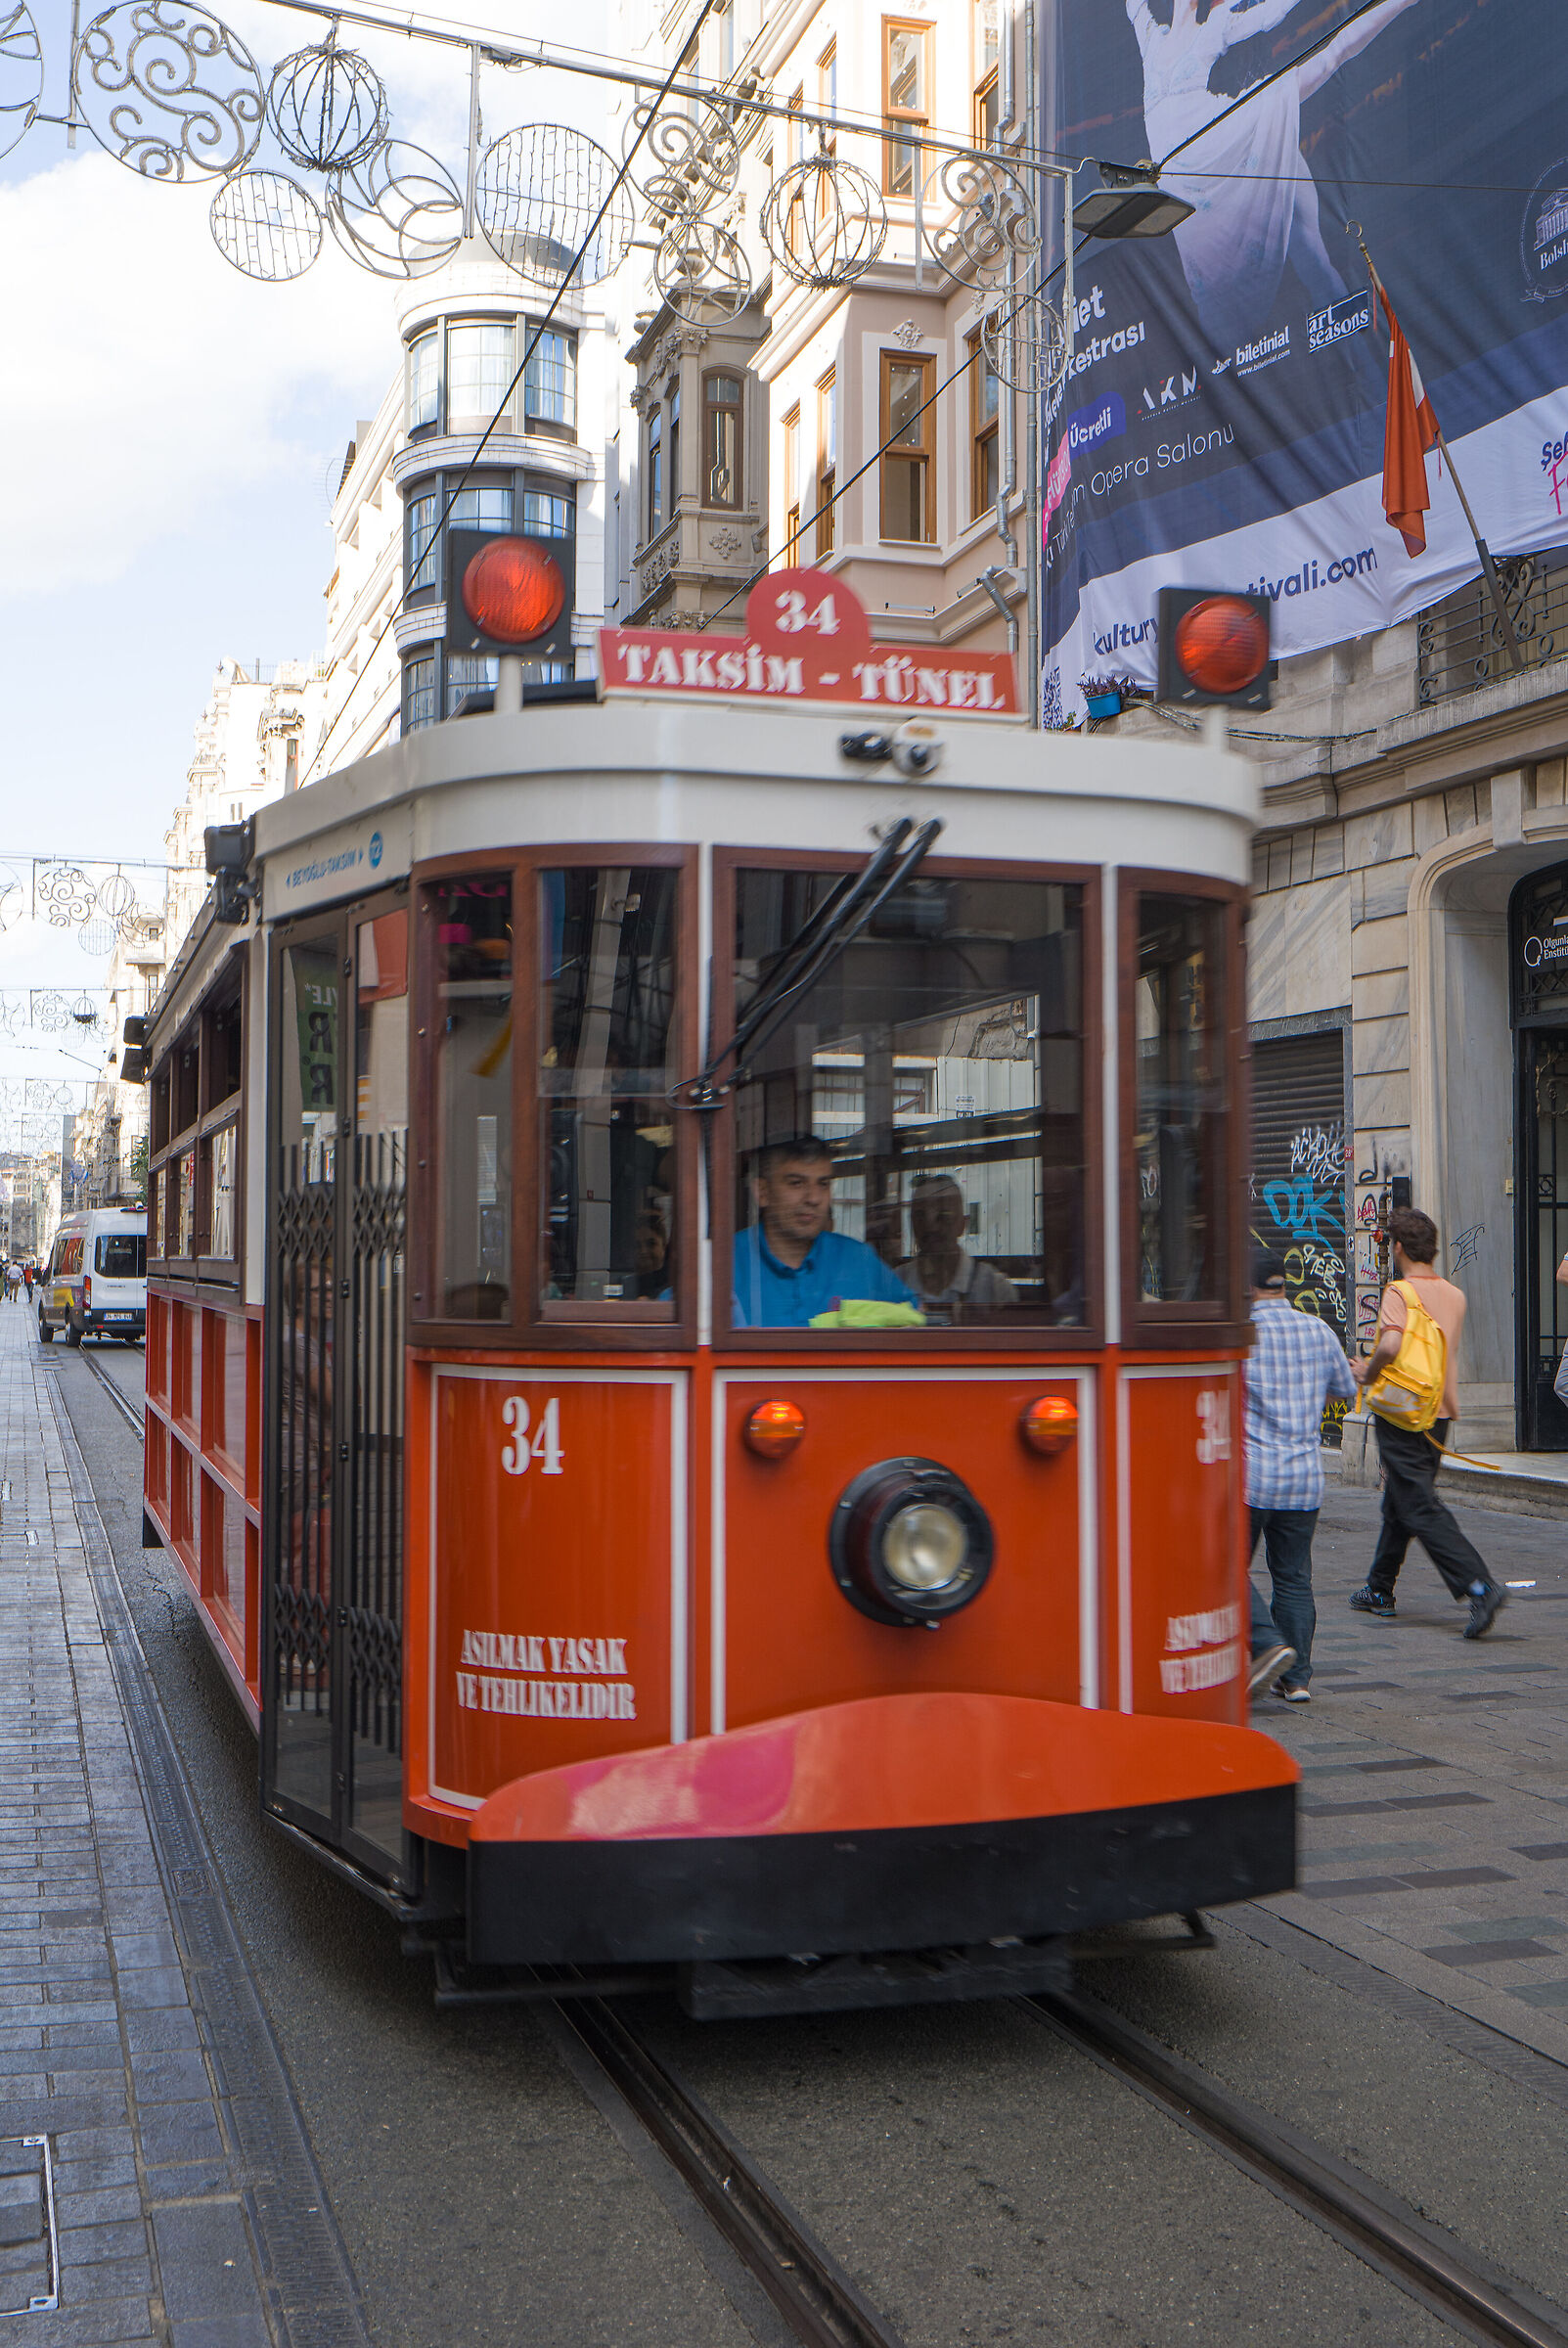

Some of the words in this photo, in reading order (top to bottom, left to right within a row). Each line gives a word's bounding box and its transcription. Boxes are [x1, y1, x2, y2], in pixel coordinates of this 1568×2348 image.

[1309, 304, 1335, 335] art
[1309, 308, 1368, 349] seasons
[1066, 321, 1145, 382] kestrası
[1235, 325, 1290, 366] biletinial
[1236, 349, 1291, 378] www.biletinial.com
[1070, 406, 1111, 448] Ücretli
[1091, 456, 1149, 496] Opera
[1156, 423, 1235, 469] Salonu
[775, 589, 841, 636] 34
[617, 642, 807, 696] TAKSİM
[853, 655, 1006, 709] TÜNEL
[501, 1395, 565, 1475] 34
[461, 1629, 546, 1673] ASILMAK
[548, 1637, 629, 1675] YASAK
[456, 1671, 478, 1710] VE
